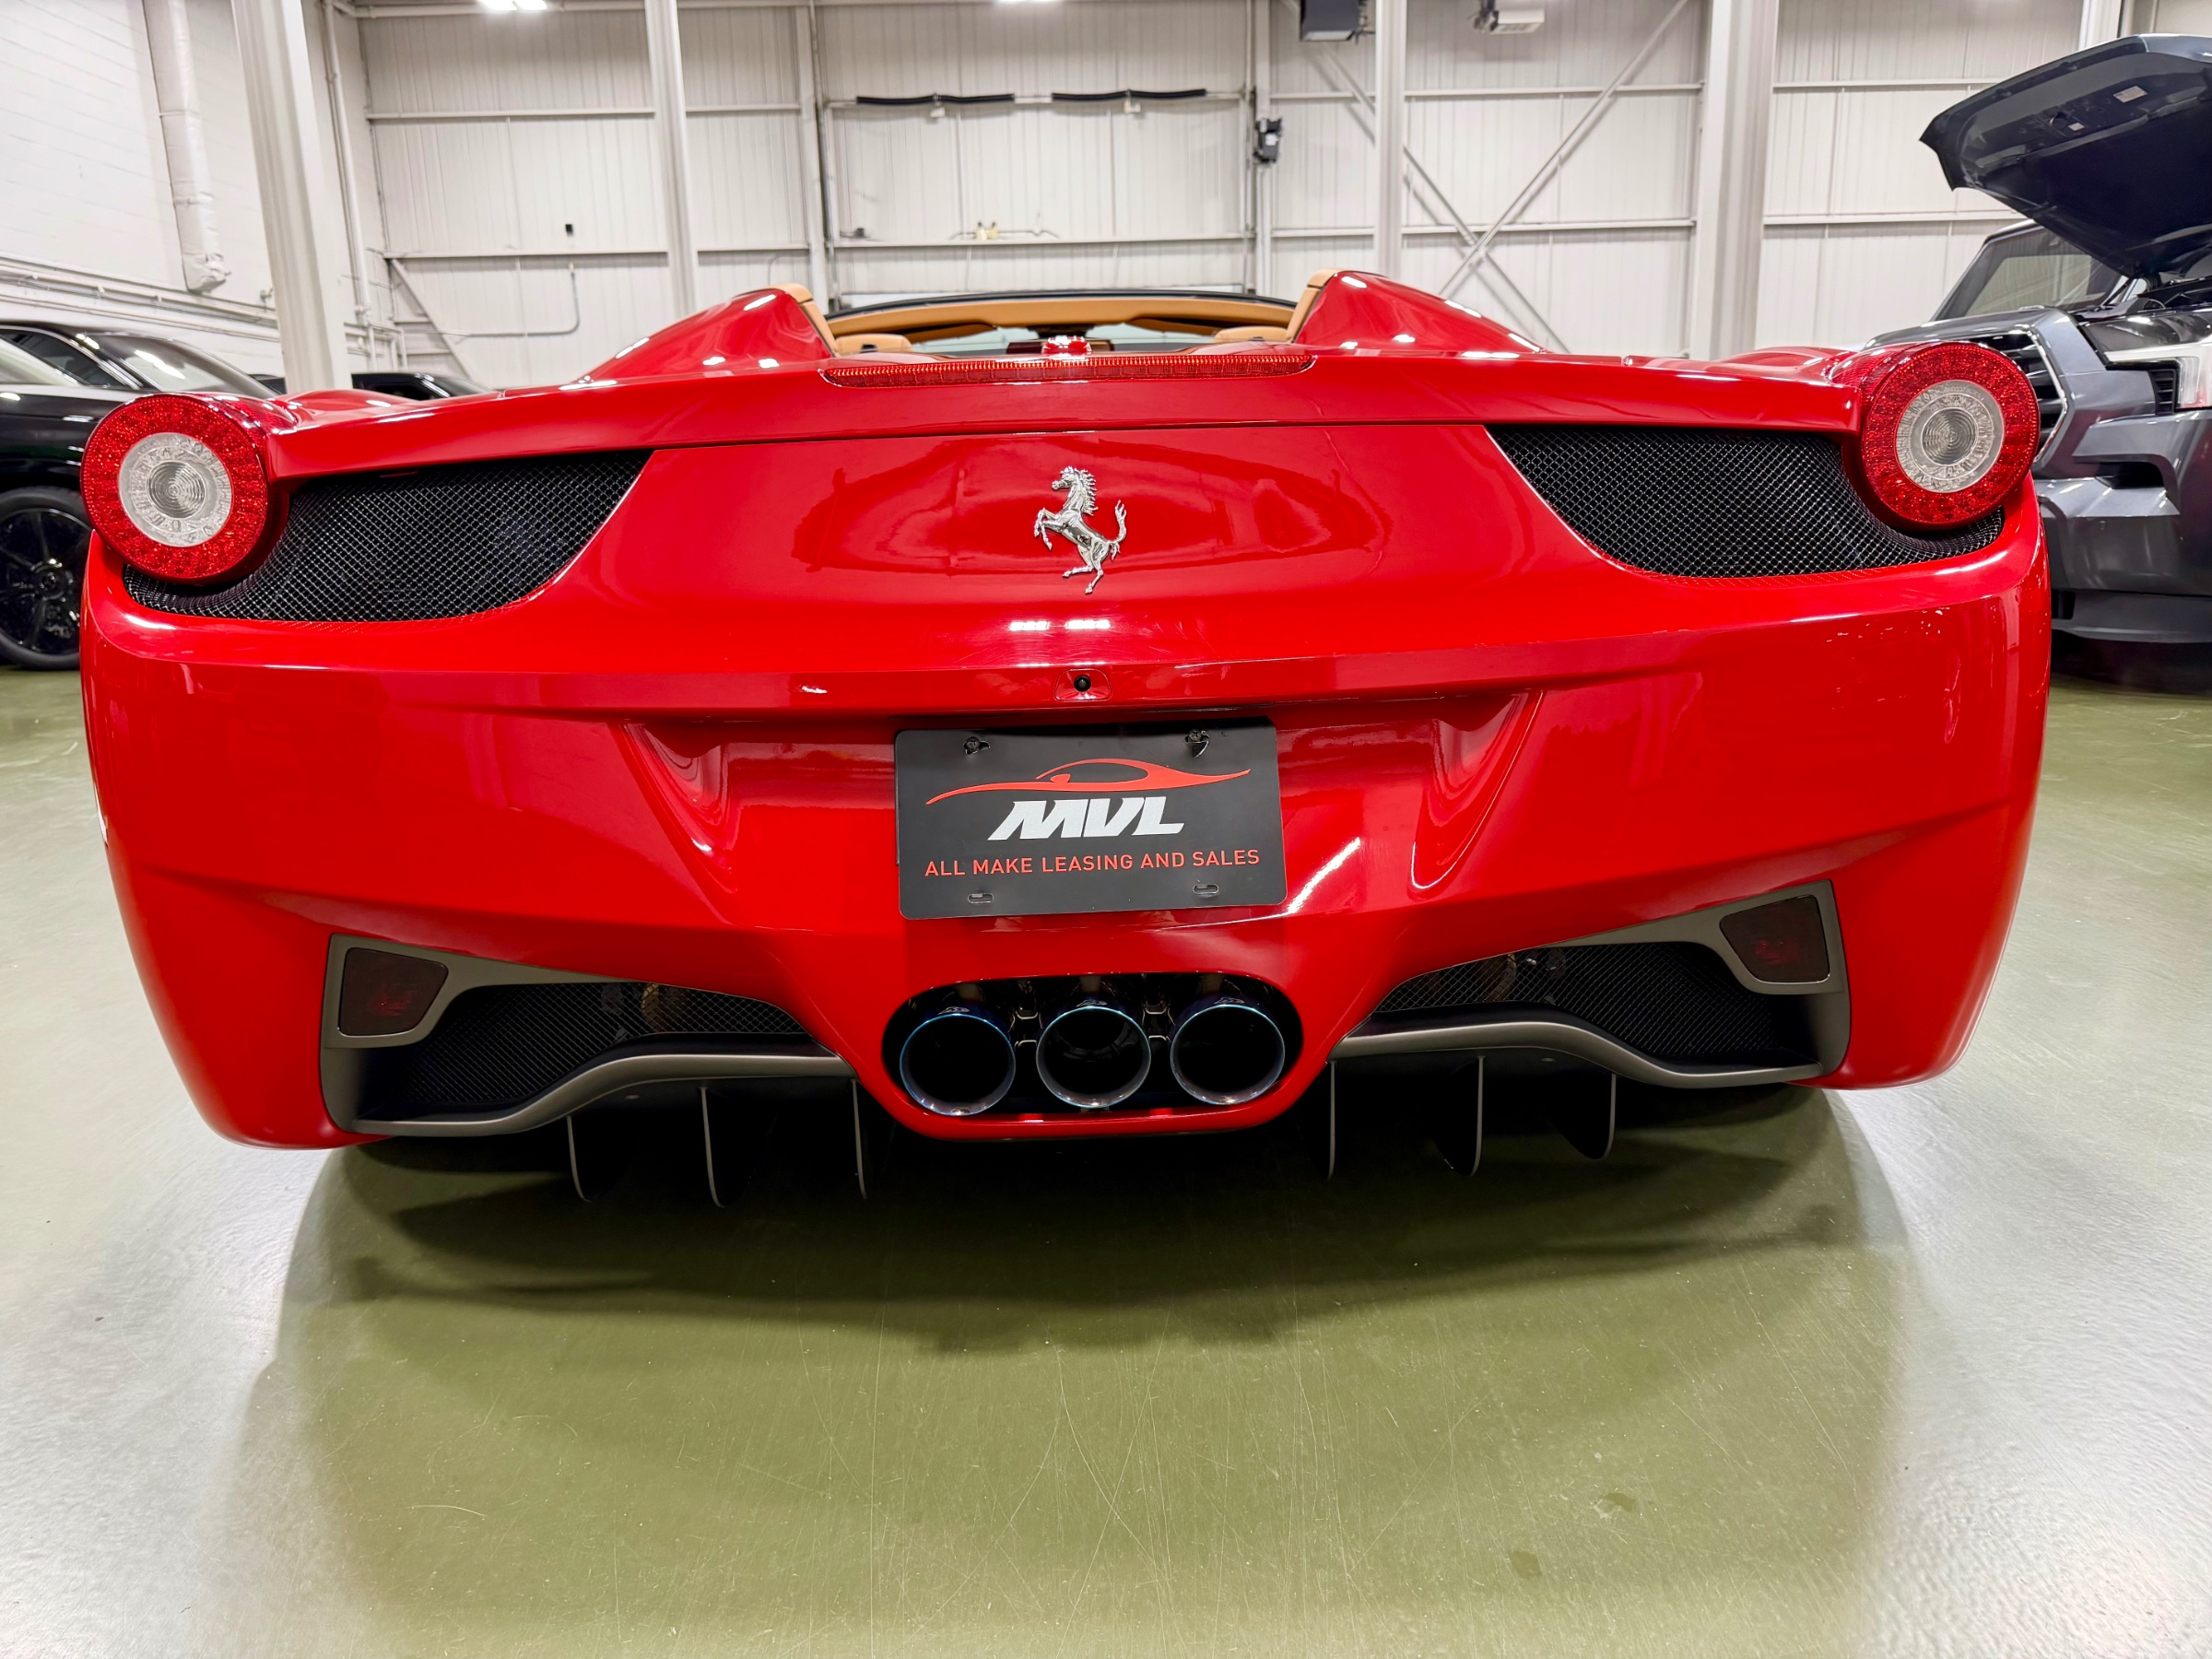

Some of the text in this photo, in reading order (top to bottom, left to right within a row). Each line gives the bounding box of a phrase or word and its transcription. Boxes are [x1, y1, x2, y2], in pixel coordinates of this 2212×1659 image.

[987, 796, 1185, 841] MVL
[924, 849, 1261, 877] ALL MAKE LEASING AND SALES
